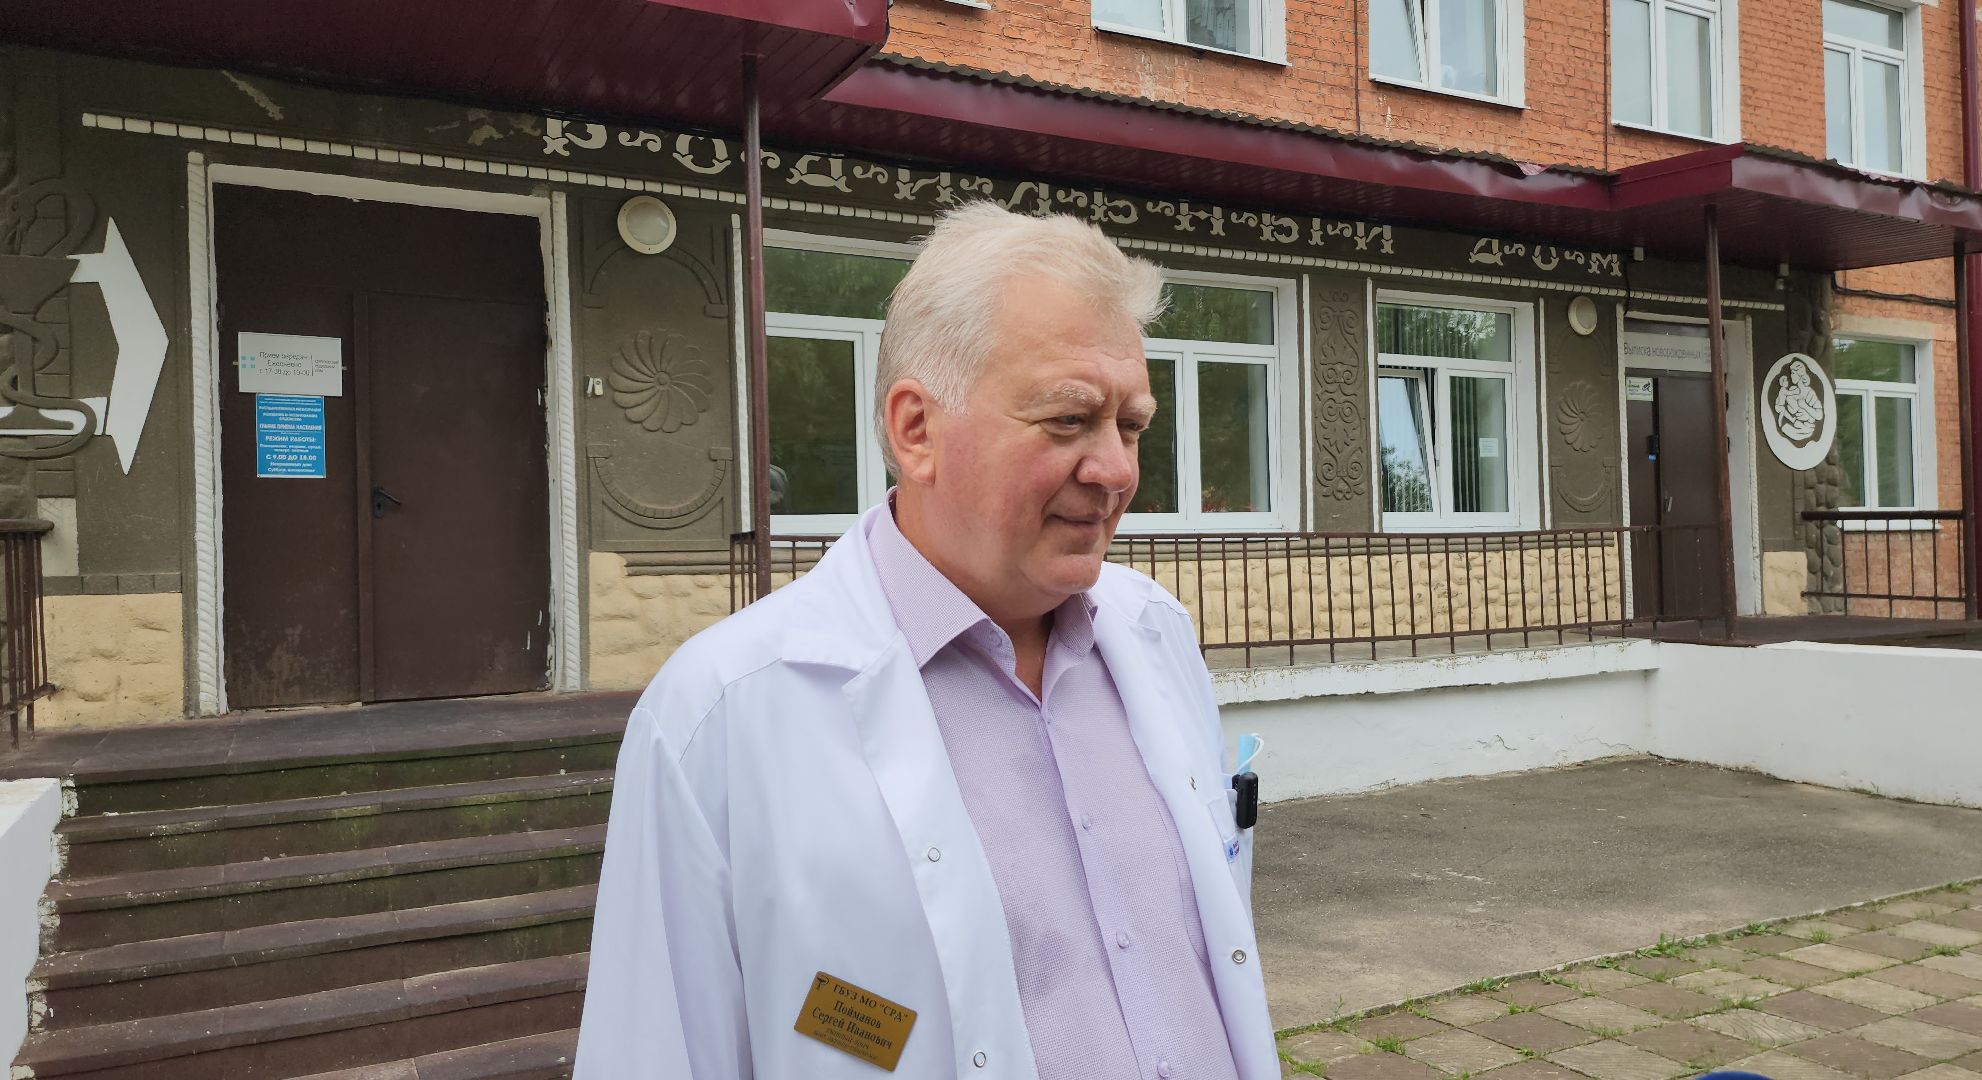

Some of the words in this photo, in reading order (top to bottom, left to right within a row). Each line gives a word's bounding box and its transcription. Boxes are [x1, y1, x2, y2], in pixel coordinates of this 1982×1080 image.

[1468, 237, 1622, 278] ДОМ
[833, 983, 858, 1000] ГБУЗ
[860, 995, 877, 1009] МО
[812, 1007, 845, 1029] Сергей
[846, 1021, 893, 1050] Иванович
[833, 1000, 882, 1029] Пойманов
